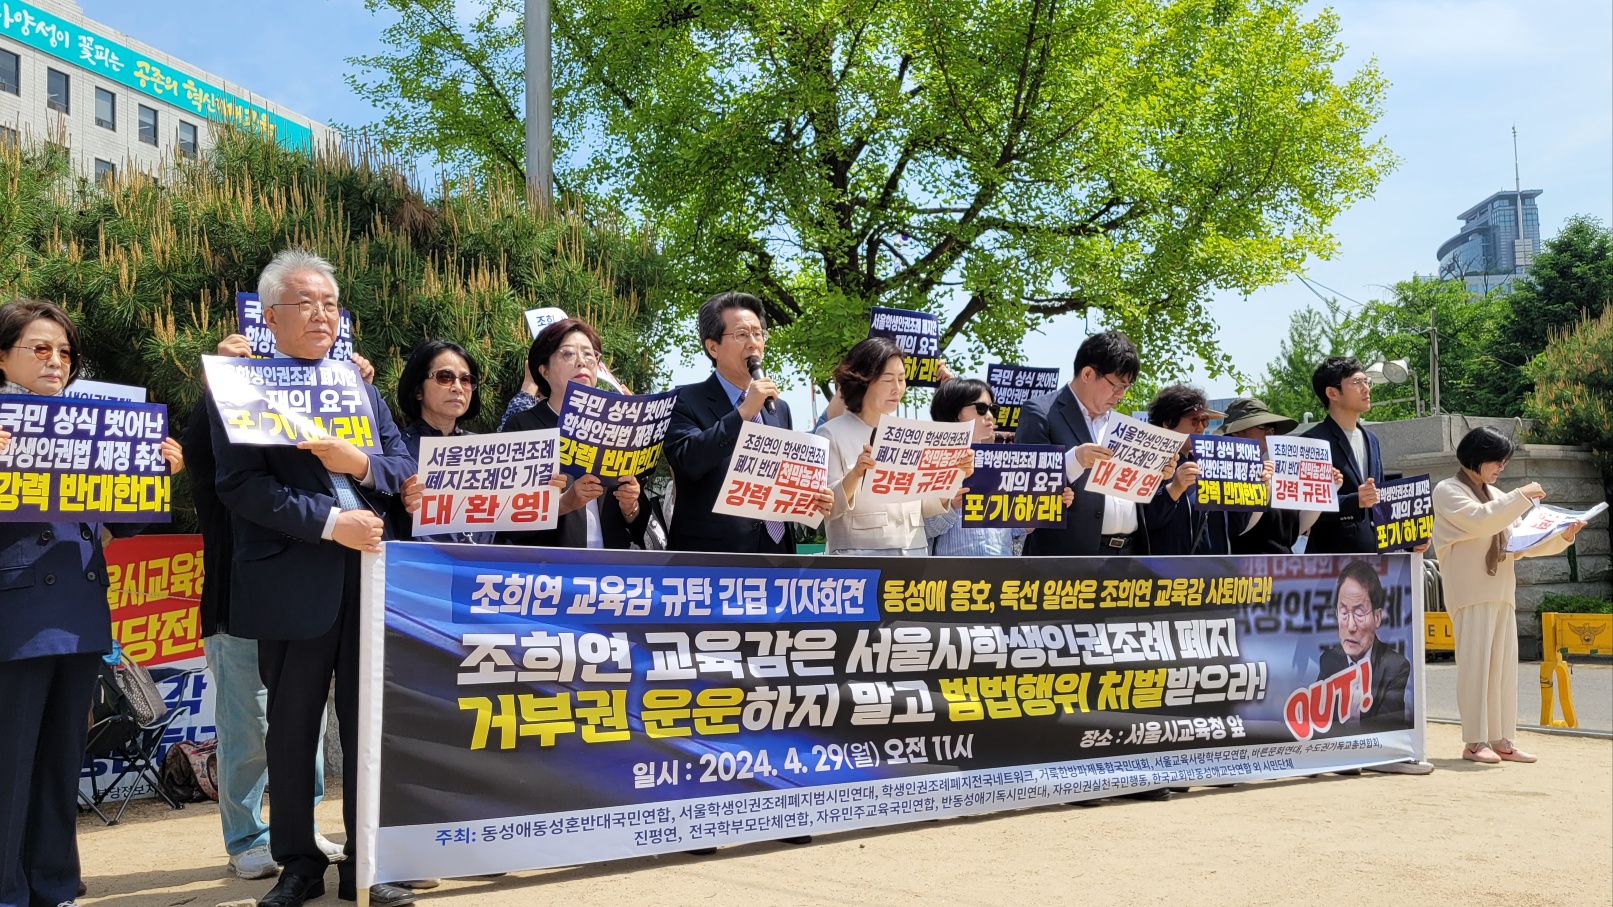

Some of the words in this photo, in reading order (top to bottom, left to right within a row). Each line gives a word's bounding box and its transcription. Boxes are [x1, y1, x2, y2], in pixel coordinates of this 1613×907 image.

[78, 35, 124, 72] 꽃피는
[133, 60, 178, 96] 공존의
[871, 313, 921, 334] 서울학생인권조례
[917, 337, 938, 357] 요구
[226, 365, 318, 387] 학생인권조례
[319, 363, 358, 387] 폐지안
[990, 368, 1014, 386] 국민
[1015, 370, 1035, 388] 상식
[1036, 372, 1059, 389] 벗어난
[266, 389, 312, 414] 재의
[320, 390, 363, 414] 요구
[568, 390, 608, 418] 국민
[607, 400, 643, 423] 상식
[642, 395, 678, 423] 벗어난
[0, 403, 48, 433] 국민
[53, 405, 98, 436] 상식
[104, 409, 163, 439] 벗어난
[561, 412, 634, 448] 학생인권법
[630, 423, 656, 447] 제정
[652, 417, 672, 442] 추진
[882, 426, 925, 446] 조희연의
[924, 430, 971, 446] 학생인권조례
[427, 439, 555, 468] 서울학생인권조례
[742, 433, 783, 456] 조희연의
[782, 440, 826, 466] 학생인권조례
[1110, 421, 1184, 454] 서울학생인권조례
[1195, 439, 1215, 458] 국민
[1216, 441, 1235, 459] 상식
[1235, 442, 1261, 461] 벗어난
[1274, 443, 1299, 458] 조희연의
[1299, 445, 1329, 462] 학생인권조례
[94, 440, 130, 472] 제정
[135, 441, 166, 472] 추진
[560, 436, 599, 474] 강력
[599, 440, 663, 477] 반대한다!
[733, 454, 759, 475] 폐지
[756, 458, 781, 480] 반대
[875, 445, 900, 464] 폐지
[900, 448, 923, 466] 반대
[974, 450, 1037, 470] 울학생인권조례
[1037, 451, 1063, 470] 폐지안
[1107, 439, 1159, 469] 폐지조례안
[1154, 456, 1173, 472] 가
[1197, 458, 1234, 480] 학생인권법
[1234, 461, 1248, 481] 제정
[1249, 463, 1264, 482] 추진
[1275, 459, 1288, 476] 폐지
[1287, 461, 1300, 476] 반대
[0, 471, 51, 511] 강력
[59, 473, 170, 512] 반대한다!
[425, 466, 518, 490] 폐지조례안
[521, 462, 555, 488] 가결
[871, 469, 915, 495] 강력
[916, 469, 959, 494] 규탄!
[998, 471, 1030, 492] 재의
[1032, 471, 1063, 493] 요구
[1092, 460, 1163, 497] 대/환/영!
[1275, 479, 1299, 502] 강력
[1302, 482, 1332, 504] 규탄!
[1376, 482, 1415, 503] 울학생인권조례
[1415, 479, 1431, 496] 폐지안
[420, 490, 550, 526] 대/환/영!
[725, 479, 773, 511] 강력
[772, 488, 819, 518] 규탄!
[964, 494, 1063, 522] 포/기/하/라!
[1197, 480, 1221, 505] 강력
[1223, 481, 1267, 506] 반대한다!
[1390, 500, 1411, 520] 재의
[1413, 496, 1432, 516] 요구
[106, 550, 204, 610] 울시교육
[470, 573, 561, 616] 조희연
[566, 576, 653, 617] 교육감
[661, 578, 711, 618] 규탄
[718, 578, 767, 616] 긴급
[775, 578, 867, 616] 기자회견
[882, 579, 948, 613] 동성애
[950, 579, 995, 612] 옹호,
[1000, 579, 1039, 611] 독선
[1042, 579, 1096, 611] 일삼은
[1099, 578, 1151, 609] 조희연
[1153, 578, 1205, 608] 교육감
[1205, 576, 1273, 606] 사퇴하라!
[112, 606, 204, 665] 당전
[457, 631, 632, 685] 조희연
[646, 628, 838, 680] 교육감은
[845, 620, 1176, 674] 서울시학생인권조례
[1174, 618, 1240, 660] 폐지
[458, 688, 631, 750] 거부권
[640, 683, 840, 739] 운운하지
[848, 679, 936, 726] 말고
[938, 672, 1092, 723] 범법행위
[1096, 661, 1268, 711] 처벌받으라!
[1285, 659, 1372, 740] OUT!
[1079, 730, 1114, 749] 장소
[1123, 718, 1227, 746] 서울시교육청
[1226, 715, 1246, 739] 앞
[632, 760, 679, 790] 일시
[699, 749, 778, 783] 2024.
[784, 747, 808, 775] 4.
[813, 741, 881, 772] 29(월)
[884, 739, 930, 766] 오전
[931, 734, 974, 762] 11시
[434, 827, 476, 846] 주최:
[480, 806, 676, 843] 동성애동성혼반대국민연합,
[679, 786, 879, 821] 서울학생인권조례폐지범시민연대,
[882, 769, 1038, 799] 학생인권조례폐지전국네트워크,
[1039, 755, 1154, 781] 거룩한방파제통합국민대회,
[1155, 746, 1250, 769] 서울교육사랑학부모연합,
[1251, 743, 1303, 758] 바른문화연대,
[634, 826, 682, 847] 진평연,
[689, 812, 814, 841] 전국학부모단체연합,
[816, 797, 939, 824] 자유민주교육국민연합,
[941, 783, 1050, 811] 반동성애기독시민연대,
[1052, 773, 1151, 796] 자유인권실천국민행동,
[1152, 762, 1251, 785] 한국교회반동성애교단연합
[1252, 761, 1261, 775] 외
[1263, 758, 1294, 772] 시민단체
